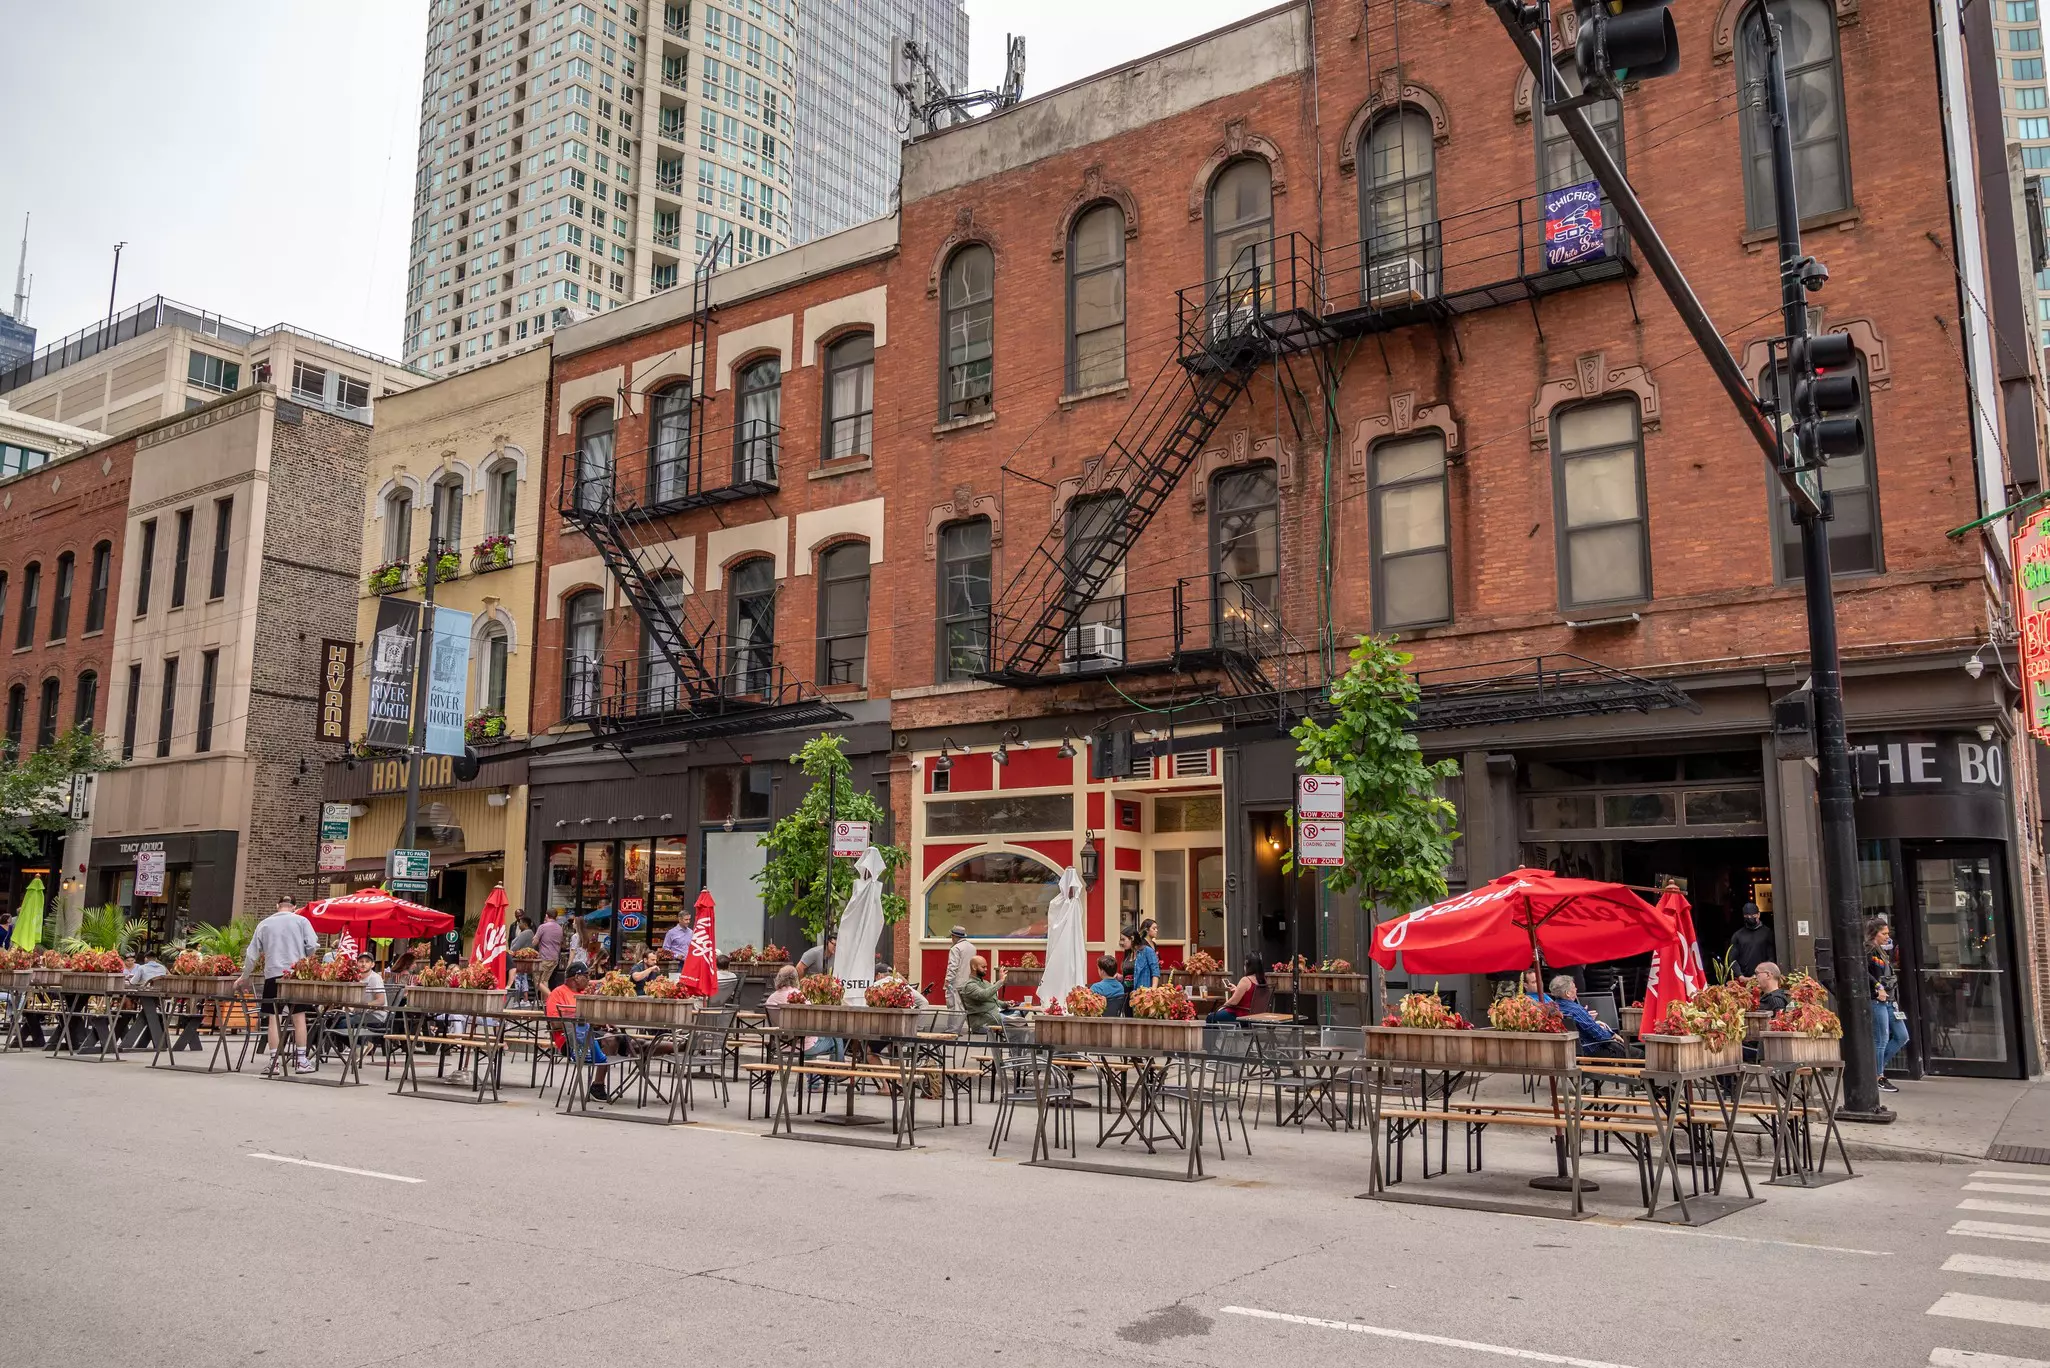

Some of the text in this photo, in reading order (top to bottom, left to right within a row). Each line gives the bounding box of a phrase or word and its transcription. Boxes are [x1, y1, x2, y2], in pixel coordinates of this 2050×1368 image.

[1548, 191, 1597, 212] CHICAGO
[1553, 223, 1595, 243] SOX
[1548, 246, 1578, 265] White
[323, 645, 347, 738] HAVANA
[371, 685, 405, 702] RIVER
[371, 700, 409, 719] NORTH
[429, 709, 463, 727] NORTH
[120, 843, 139, 853] TRACY
[622, 900, 641, 910] OPEN
[624, 917, 639, 927] ATM
